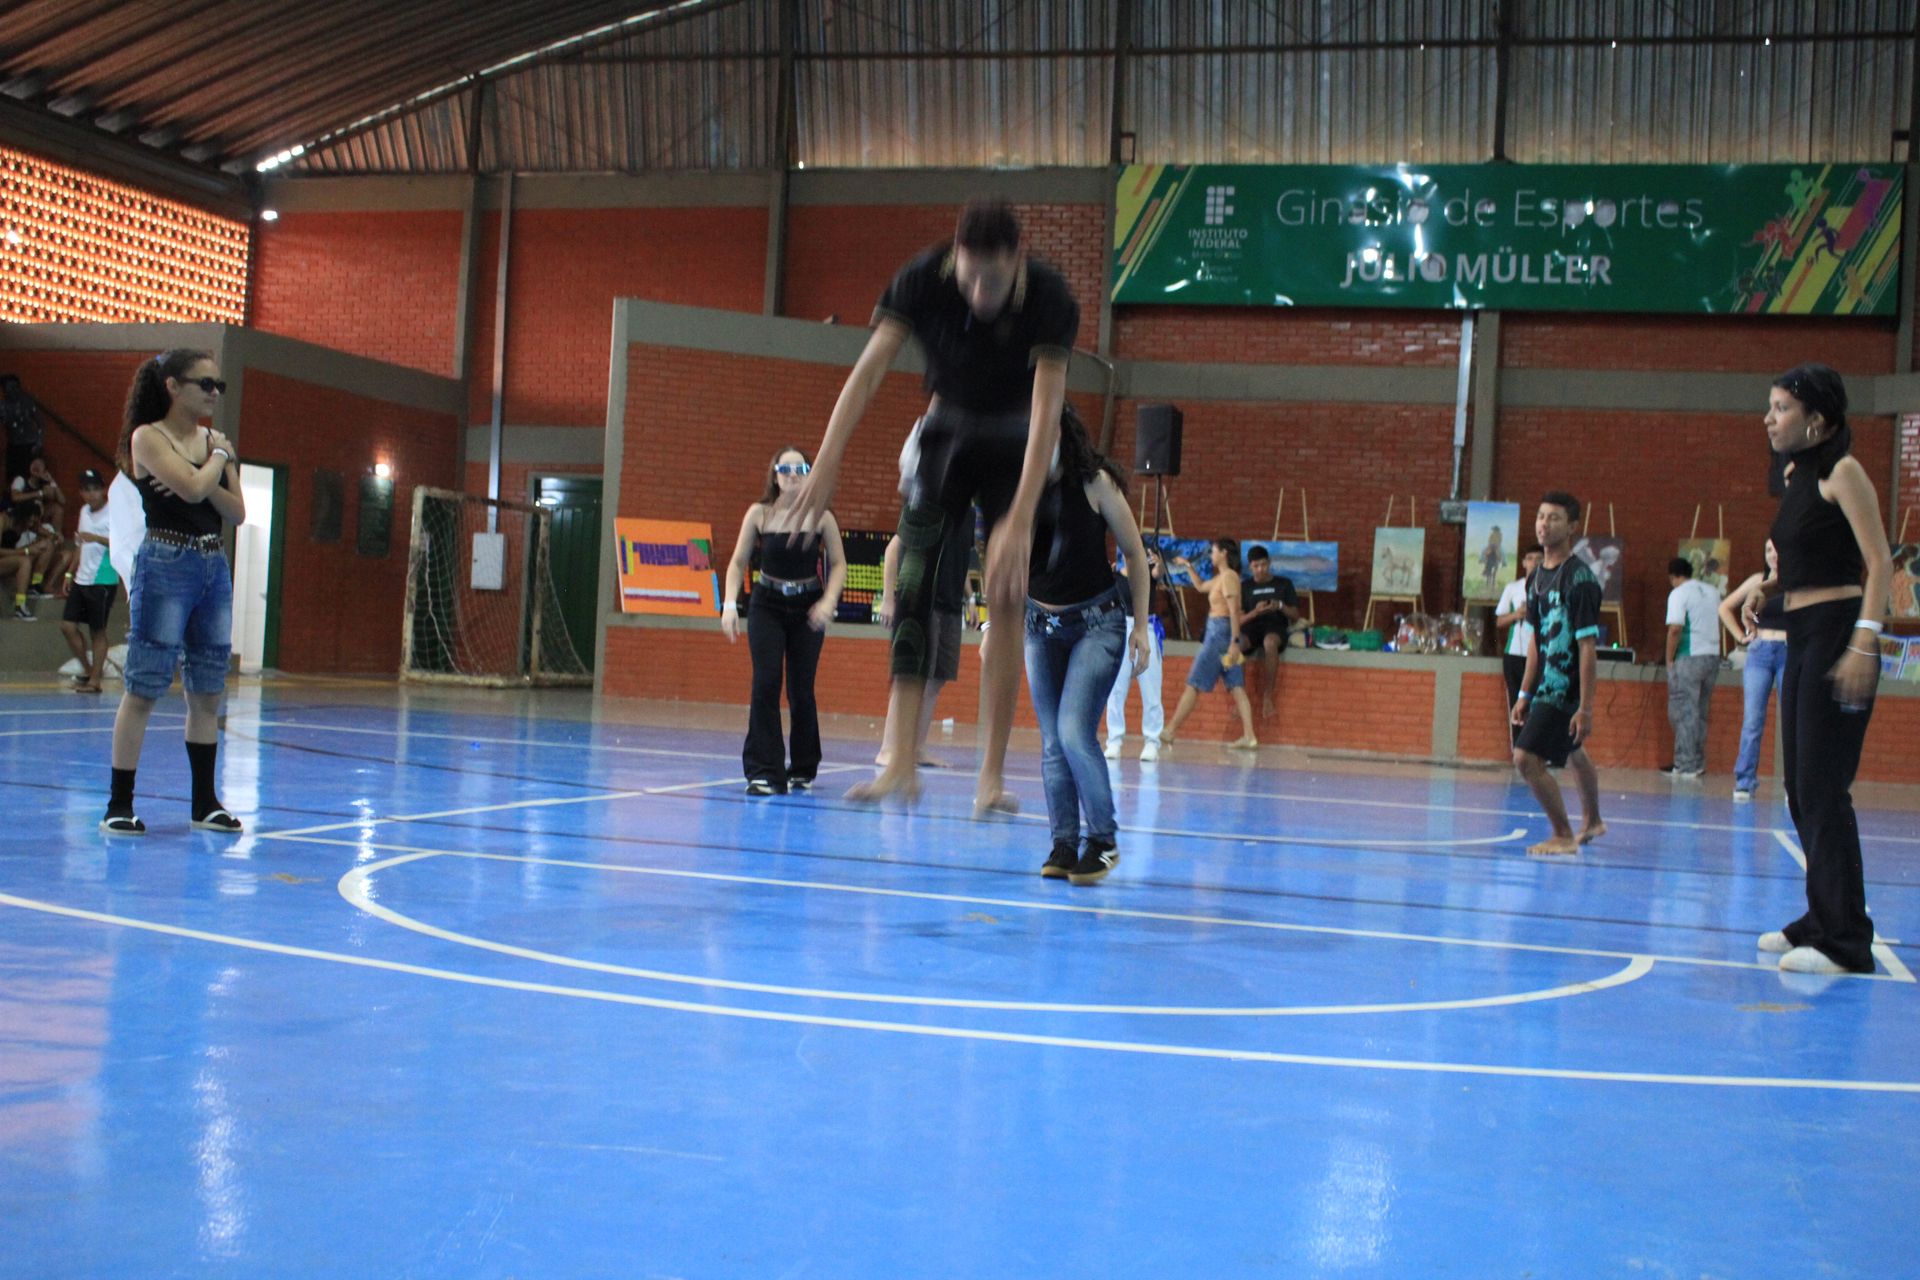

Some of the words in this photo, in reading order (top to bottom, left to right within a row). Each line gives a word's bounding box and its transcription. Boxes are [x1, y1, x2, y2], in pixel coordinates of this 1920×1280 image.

[1445, 187, 1496, 227] de
[1514, 189, 1703, 238] Esportes
[1188, 228, 1248, 239] INSTITUTO
[1193, 238, 1241, 249] FEDERAL
[1456, 245, 1612, 285] MÜLLER
